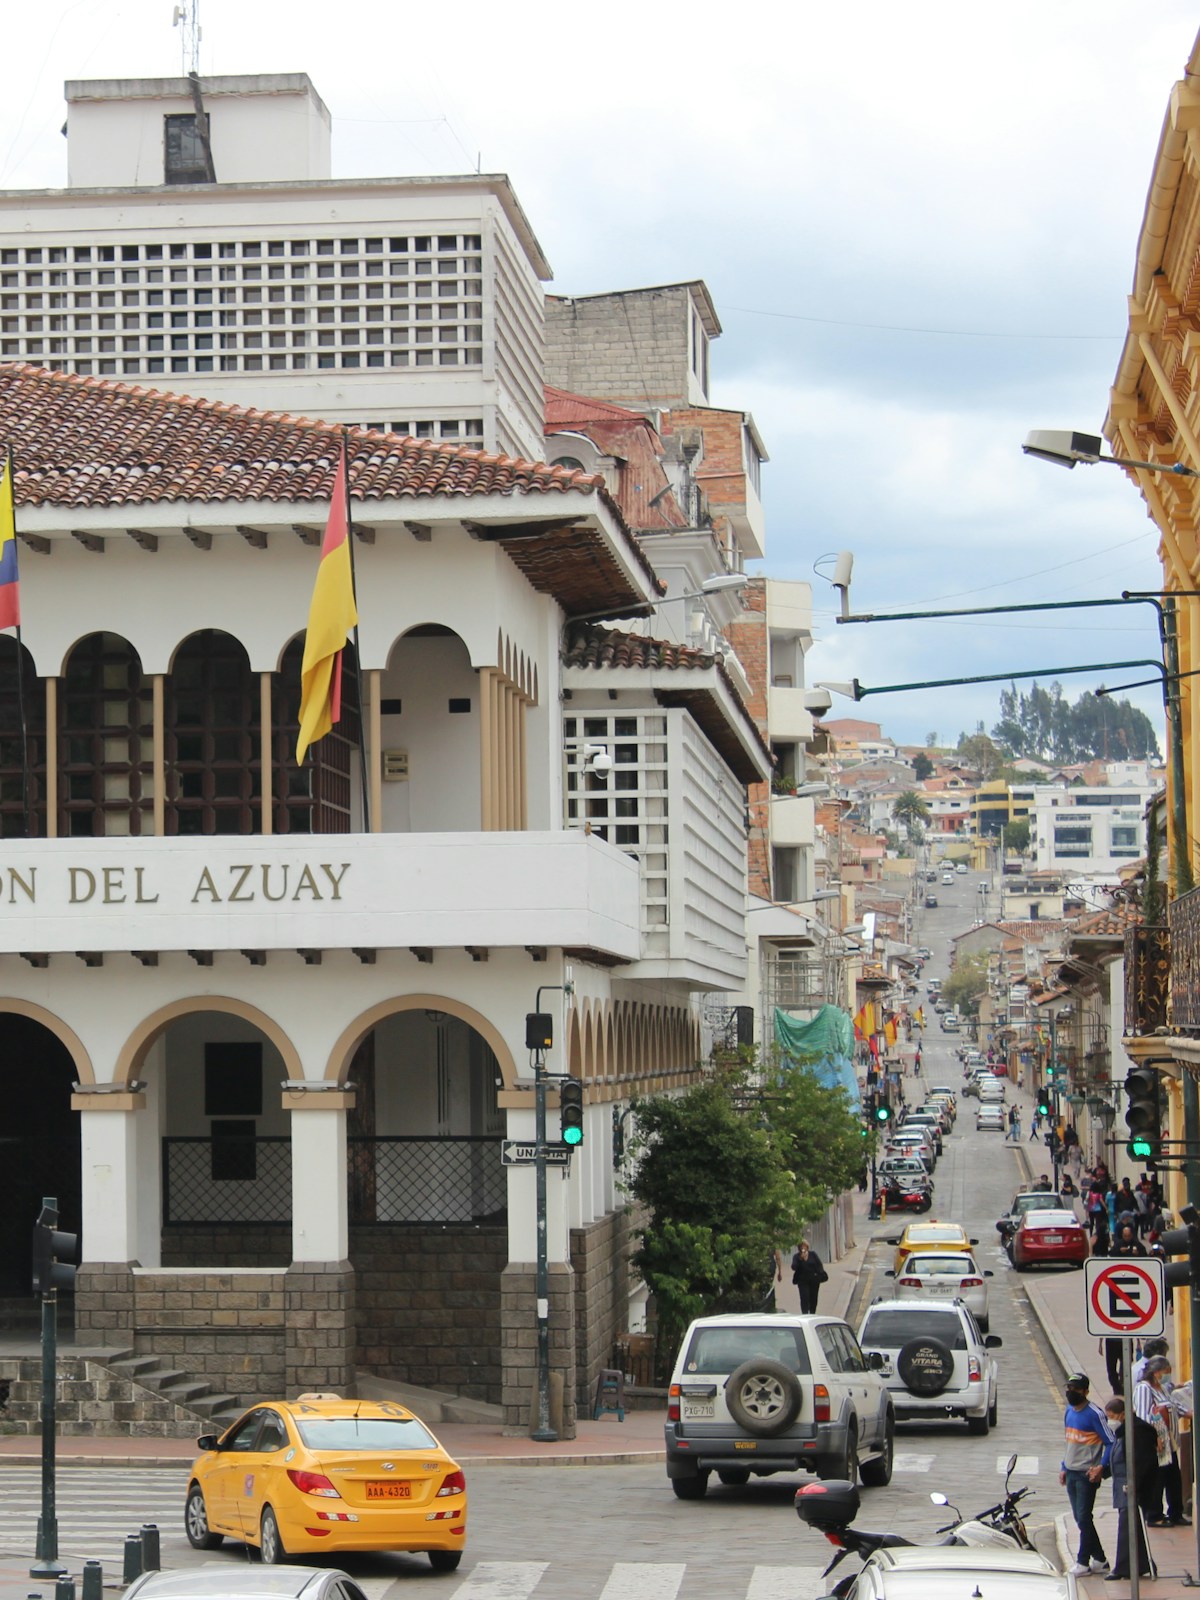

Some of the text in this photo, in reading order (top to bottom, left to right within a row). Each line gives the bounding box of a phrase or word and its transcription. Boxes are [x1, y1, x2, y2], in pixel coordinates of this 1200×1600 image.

[68, 866, 160, 904] DEL
[191, 862, 351, 902] AZUAY
[1109, 1277, 1141, 1318] E
[684, 1406, 713, 1415] PXG-710
[367, 1487, 411, 1497] AAA-4320
